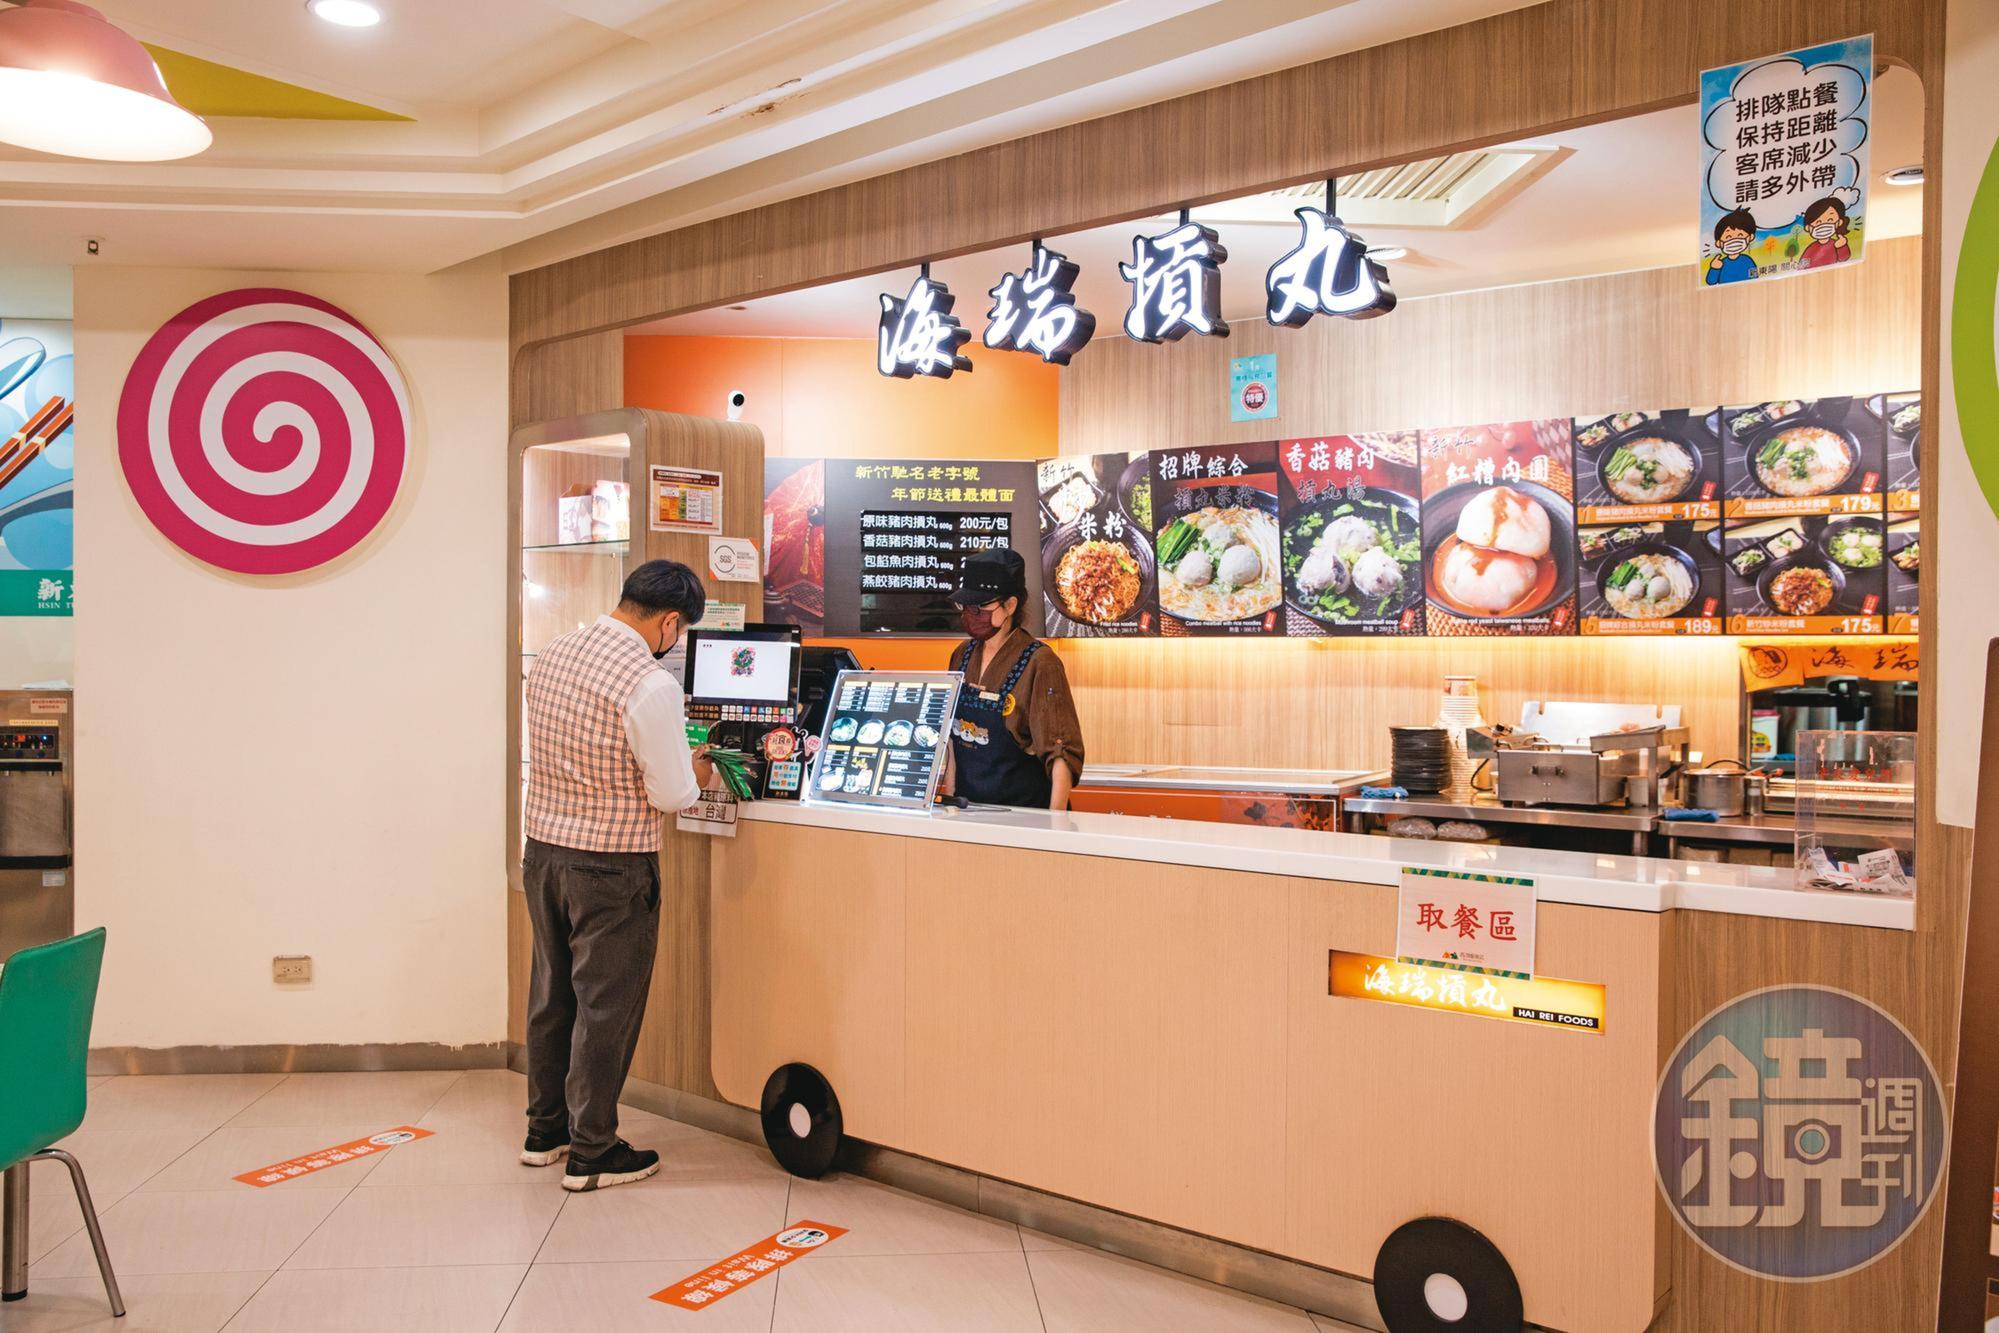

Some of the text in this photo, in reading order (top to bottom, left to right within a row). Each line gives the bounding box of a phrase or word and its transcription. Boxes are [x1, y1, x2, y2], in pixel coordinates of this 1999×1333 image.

[1735, 81, 1838, 122] 排隊點餐
[1735, 109, 1838, 149] 保持距離
[1735, 138, 1837, 176] 客席減少
[1735, 164, 1836, 203] 請多外帶
[880, 208, 1377, 374] 海瑞摃丸
[855, 465, 980, 481] 新竹馳名老字號
[1158, 450, 1249, 480] 招牌綜合
[1286, 441, 1375, 473] 香菇豬肉
[1446, 454, 1549, 486] 紅糟肉圓
[891, 487, 1015, 502] 年節送禮最體面
[960, 517, 1008, 530] 200元/包
[1078, 510, 1127, 540] 米粉
[960, 536, 1009, 549] 210元/包
[720, 555, 732, 563] SGS
[1416, 903, 1518, 941] 取餐區
[1364, 963, 1507, 1011] 海瑞摃丸
[1518, 1009, 1594, 1027] HAI REI FOODS
[683, 1253, 756, 1289] Wait in line
